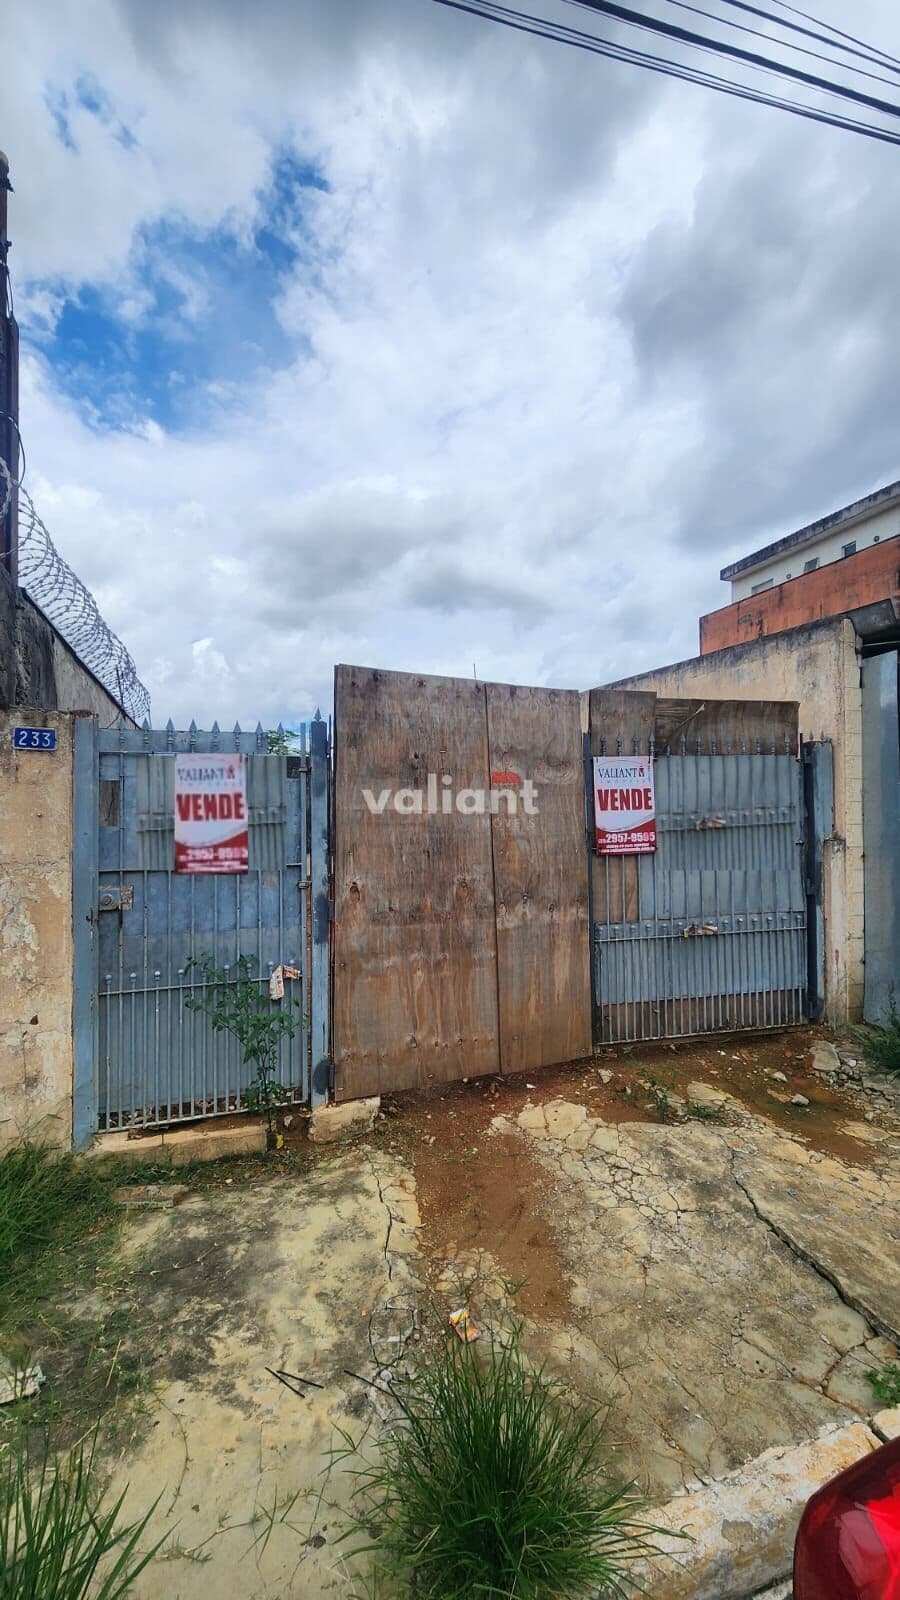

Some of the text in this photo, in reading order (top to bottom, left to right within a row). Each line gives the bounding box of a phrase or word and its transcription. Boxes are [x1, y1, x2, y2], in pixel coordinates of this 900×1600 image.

[18, 730, 51, 747] 233
[598, 767, 638, 779] VALIANT
[176, 792, 245, 822] VENDE
[597, 787, 653, 812] VENDE
